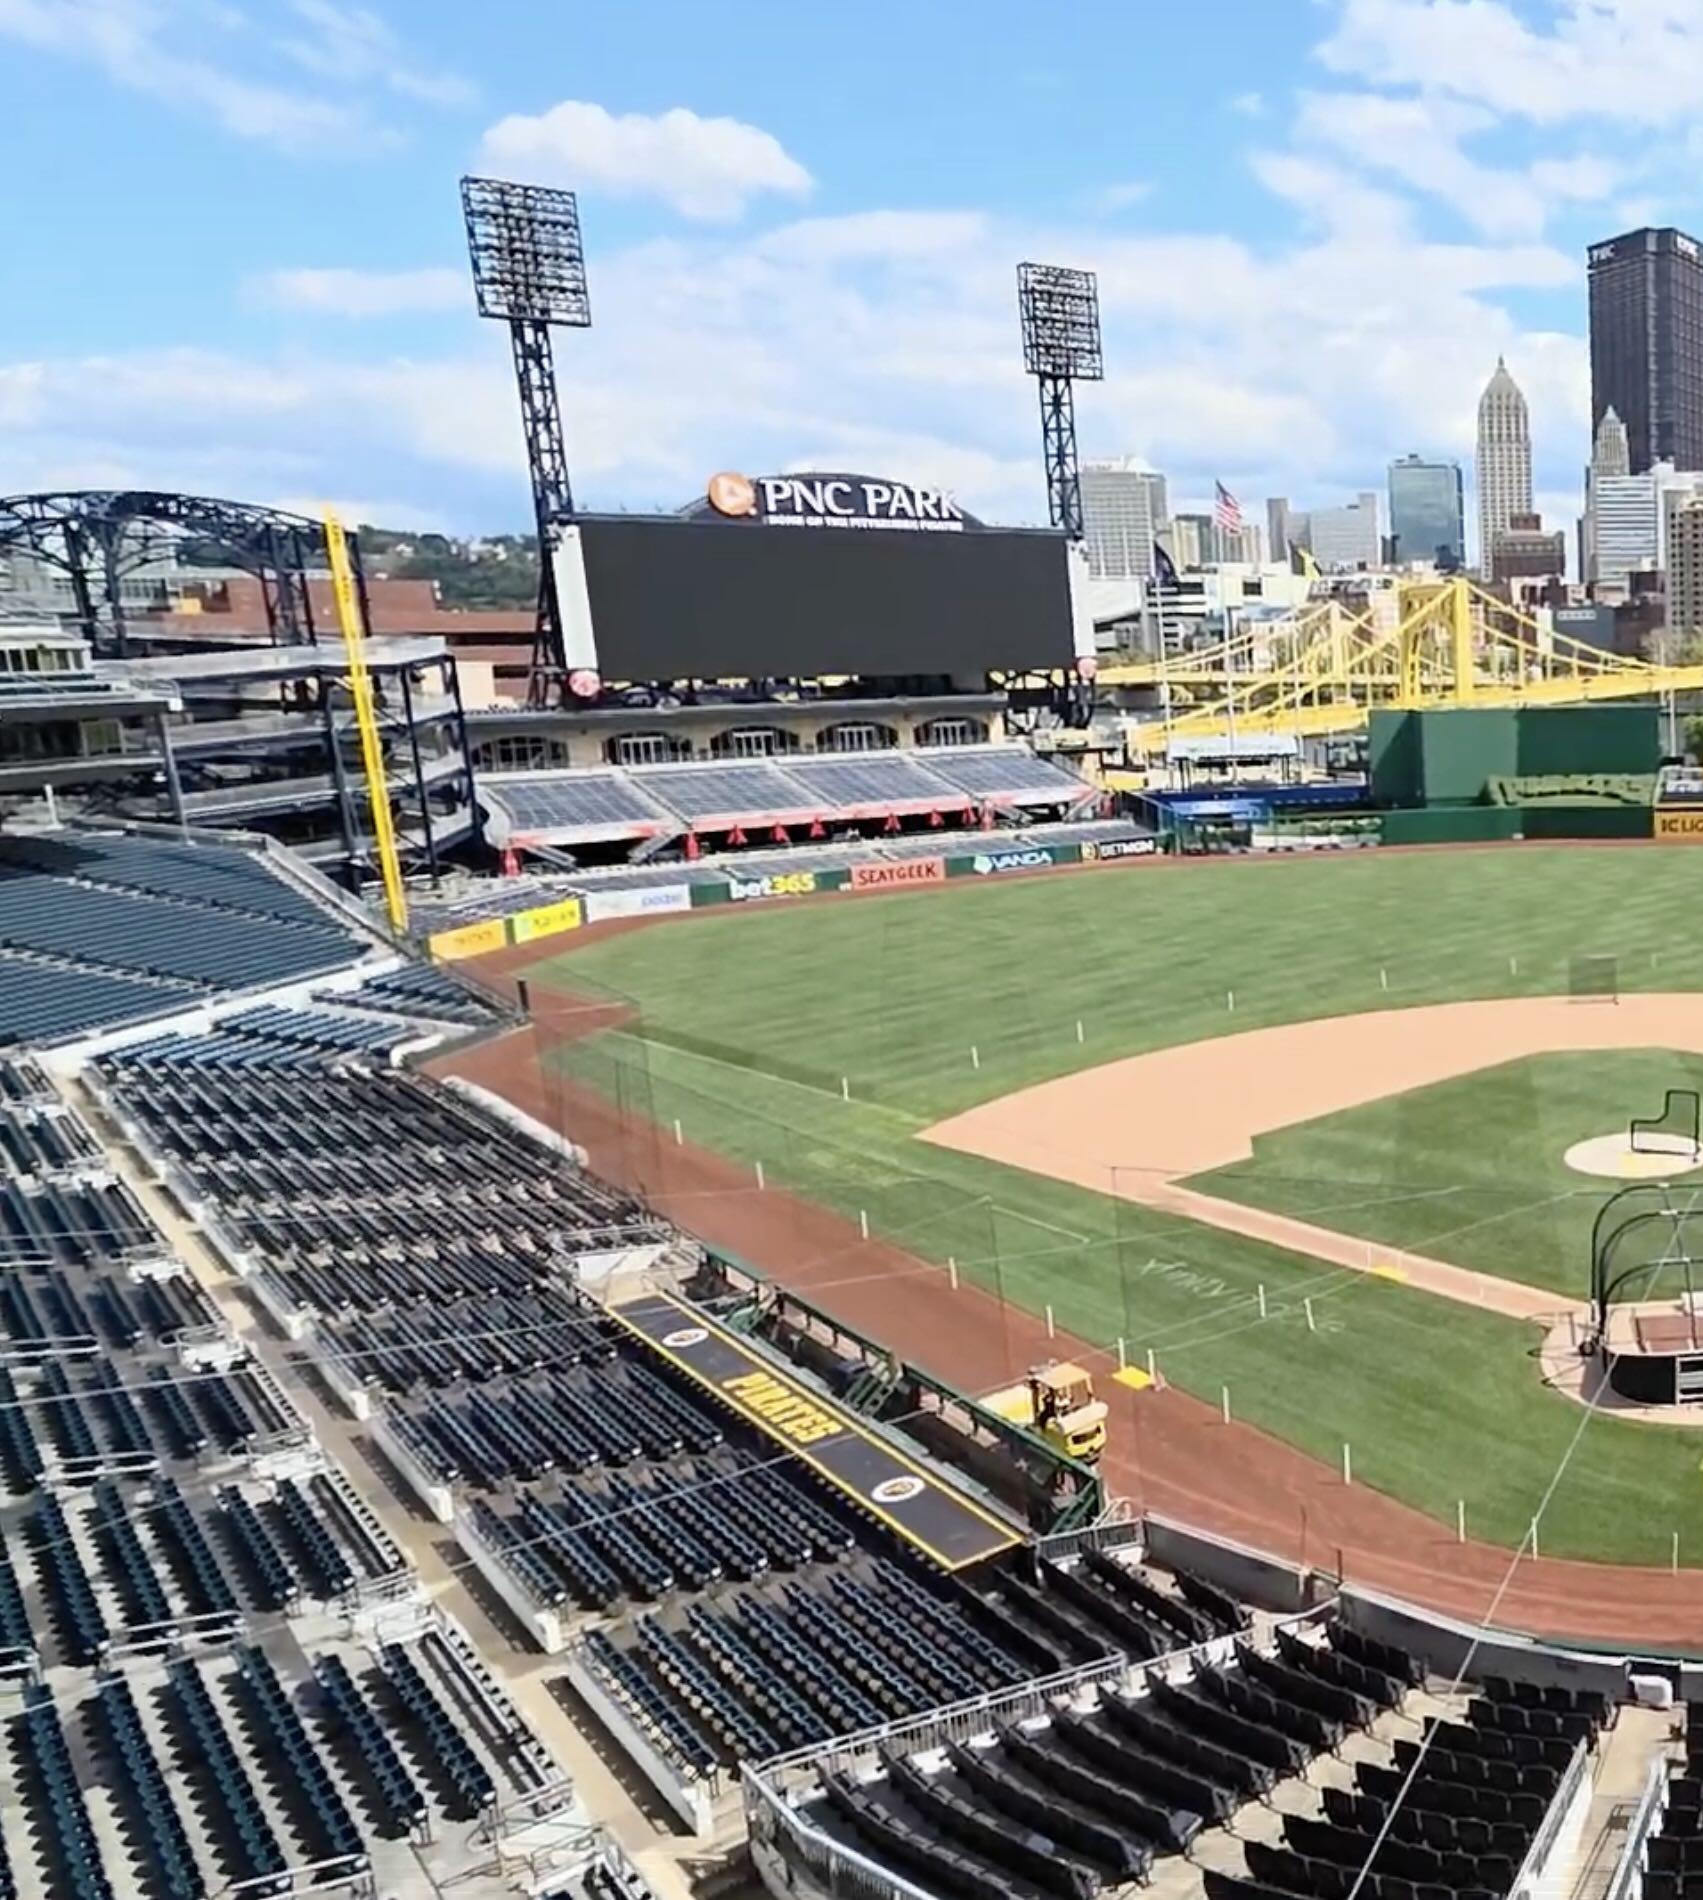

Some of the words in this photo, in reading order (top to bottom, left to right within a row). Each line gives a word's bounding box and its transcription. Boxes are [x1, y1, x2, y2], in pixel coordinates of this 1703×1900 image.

[759, 479, 855, 515] PNC
[860, 483, 963, 520] PARK
[857, 861, 938, 886] SEATGEEK
[993, 850, 1052, 872] VANDA
[729, 872, 817, 900] bet365
[721, 1372, 843, 1444] PIRATES
